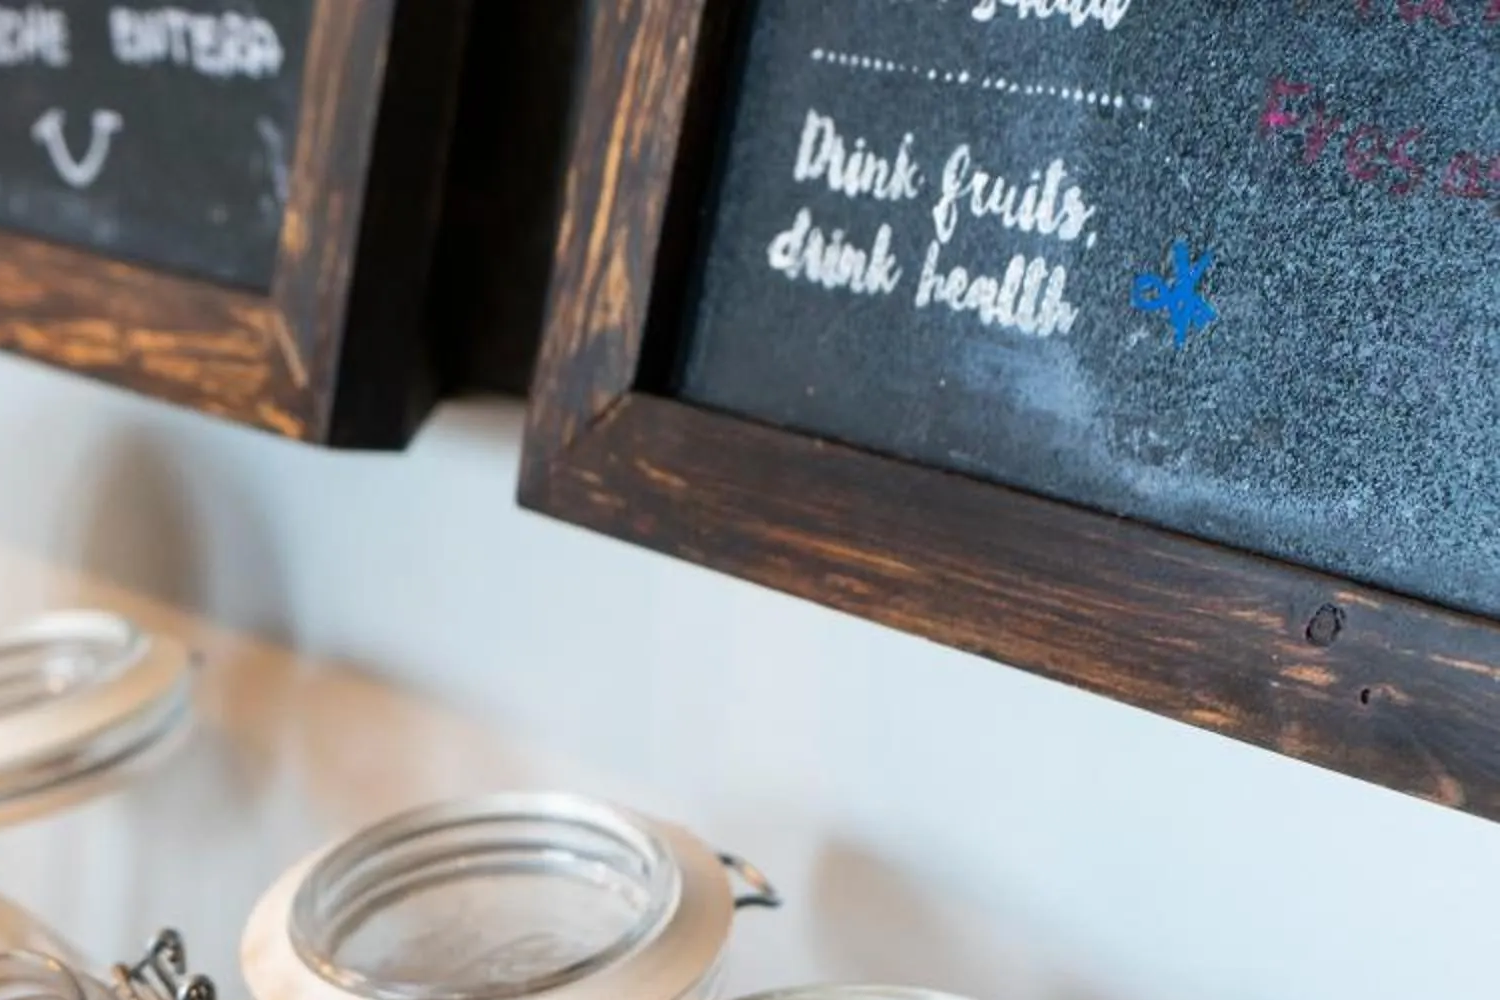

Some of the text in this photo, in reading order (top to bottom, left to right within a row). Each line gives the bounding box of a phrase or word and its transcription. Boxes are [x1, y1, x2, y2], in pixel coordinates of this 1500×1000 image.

[794, 108, 921, 201] Drink
[766, 206, 1080, 336] drink health
